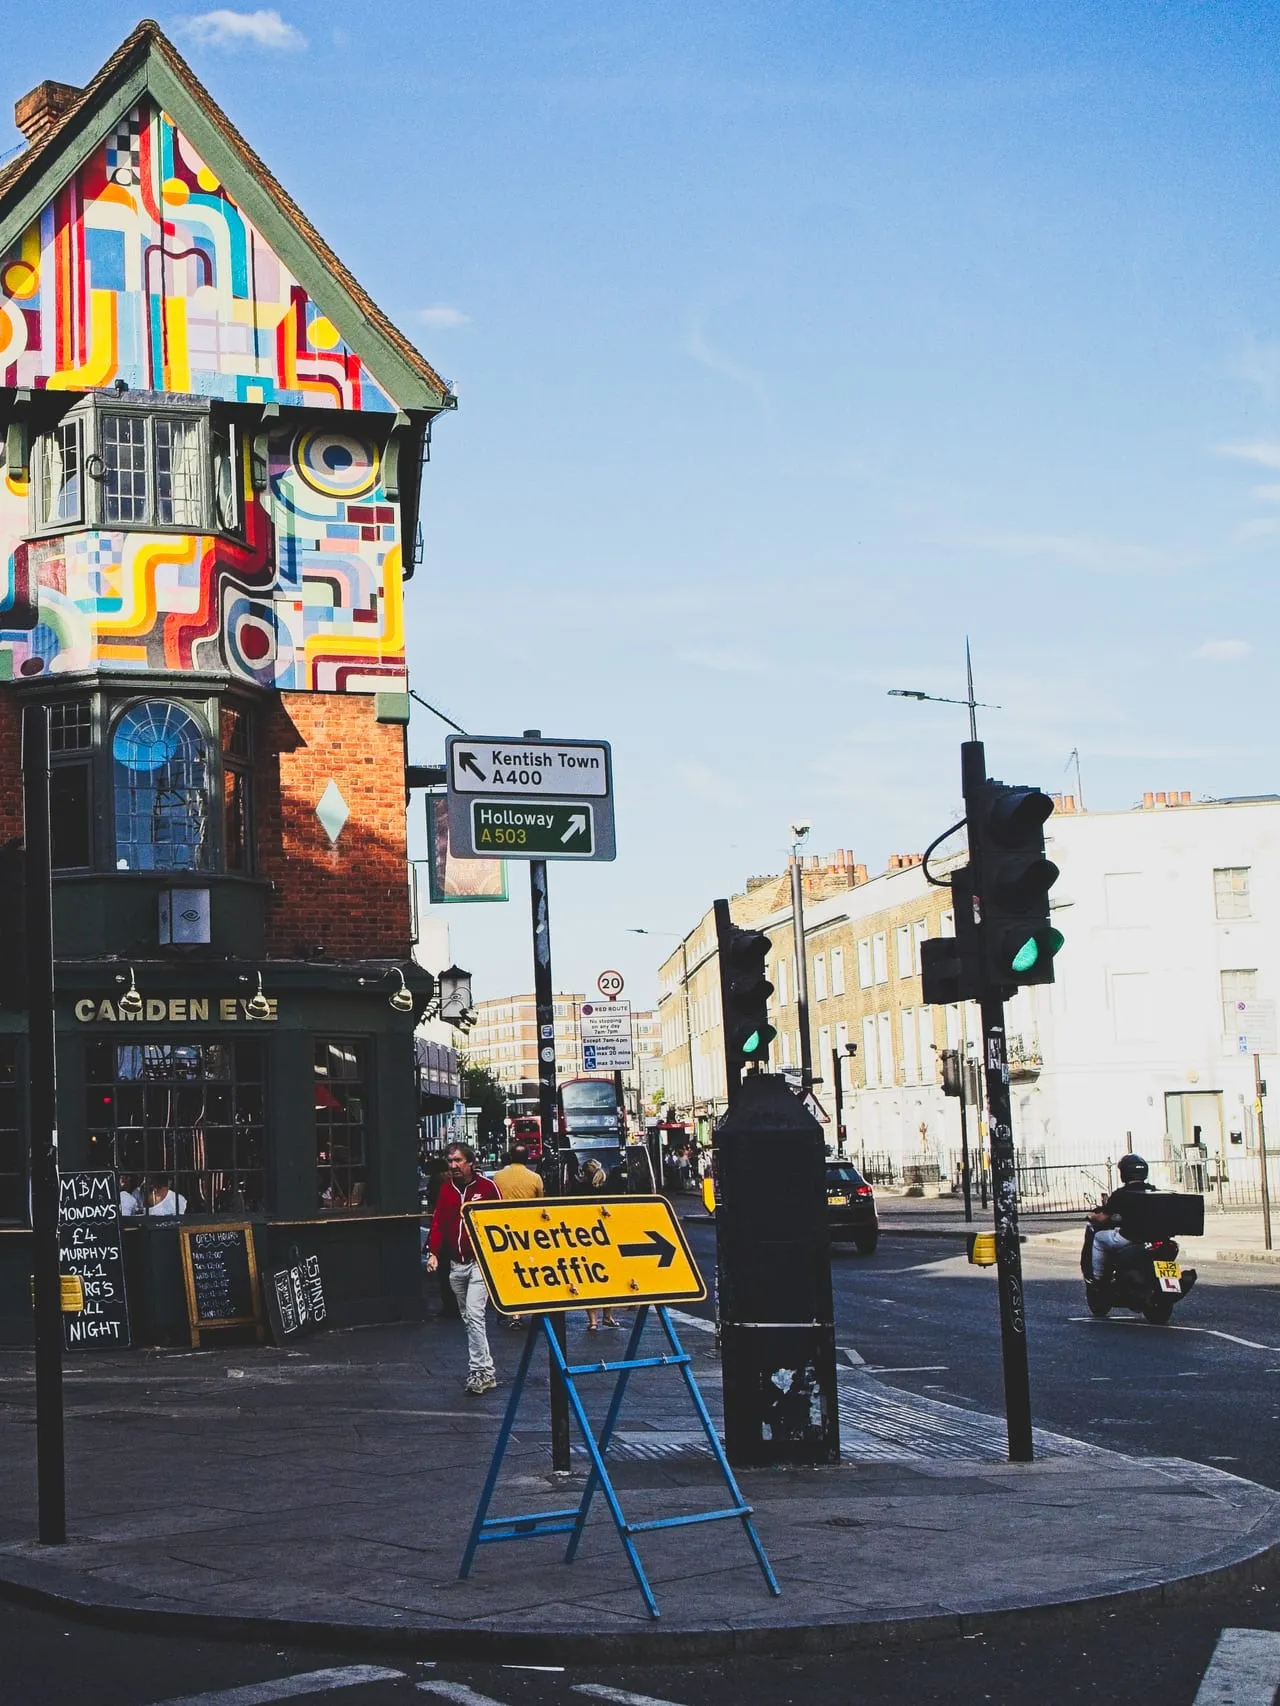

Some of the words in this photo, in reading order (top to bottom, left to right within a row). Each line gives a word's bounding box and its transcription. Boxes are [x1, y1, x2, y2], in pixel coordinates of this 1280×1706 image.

[492, 751, 552, 768] Kentish
[558, 753, 600, 769] Town
[492, 770, 542, 785] A400
[480, 809, 555, 829] Holloway
[481, 829, 527, 844] A503
[601, 978, 620, 989] 20
[59, 1204, 117, 1221] MONDAYS
[72, 1228, 97, 1244] £4
[195, 1232, 216, 1244] OPEN
[484, 1219, 611, 1253] Diverted
[59, 1247, 119, 1262] MURPHY'S
[513, 1256, 609, 1289] traffic
[1160, 1270, 1177, 1278] NTZ
[1165, 1279, 1176, 1289] L
[309, 1277, 327, 1322] PINTS
[70, 1321, 121, 1343] NIGHT
